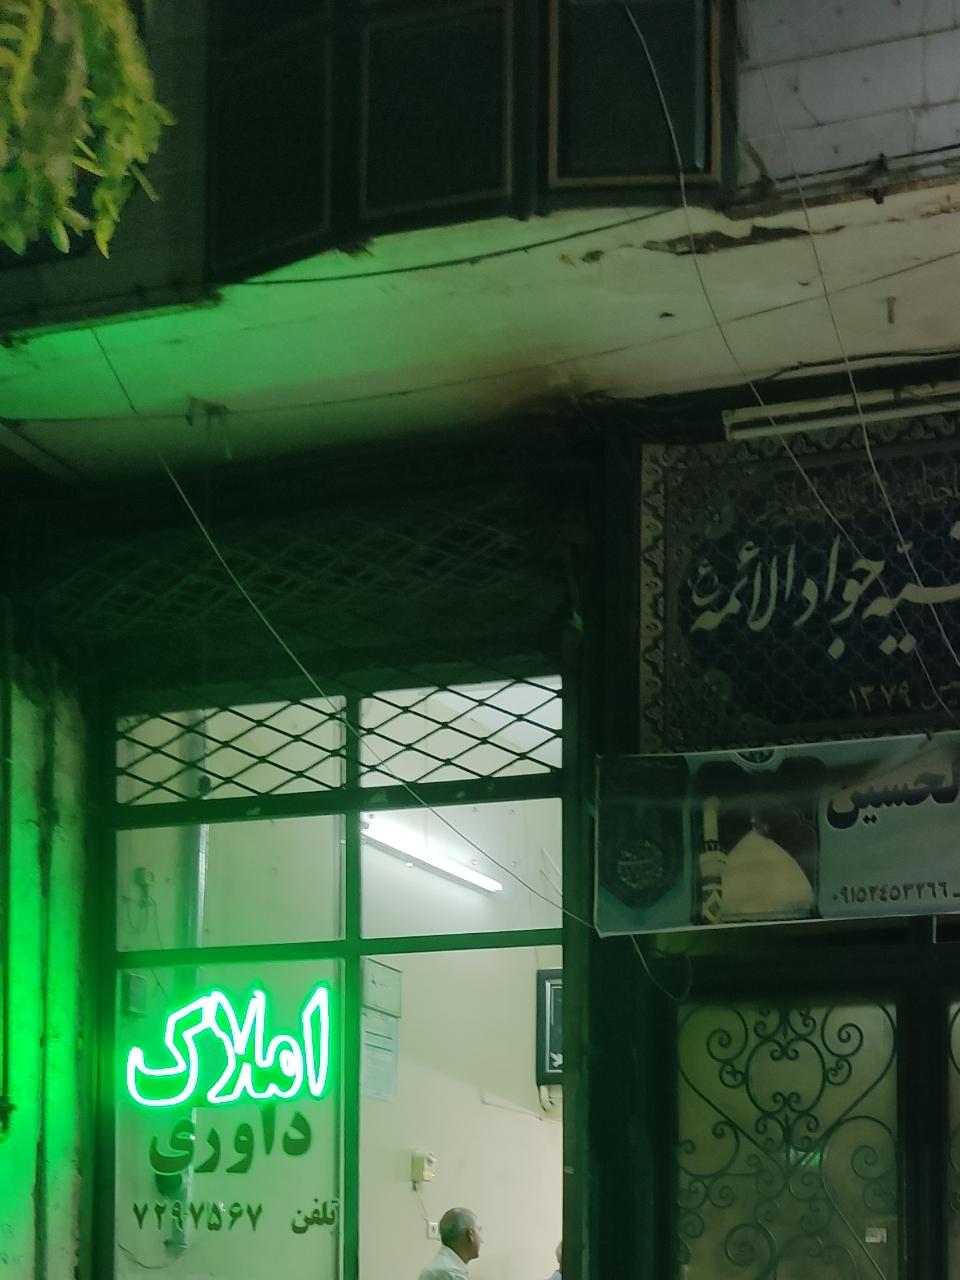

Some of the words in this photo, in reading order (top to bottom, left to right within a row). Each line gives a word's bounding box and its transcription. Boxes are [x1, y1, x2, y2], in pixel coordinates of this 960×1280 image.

[126, 985, 331, 1109] املاک
[147, 1103, 314, 1177] داوری
[133, 1201, 263, 1232] ۷۲۹۷۵۶۷
[290, 1196, 340, 1235] تلفن
